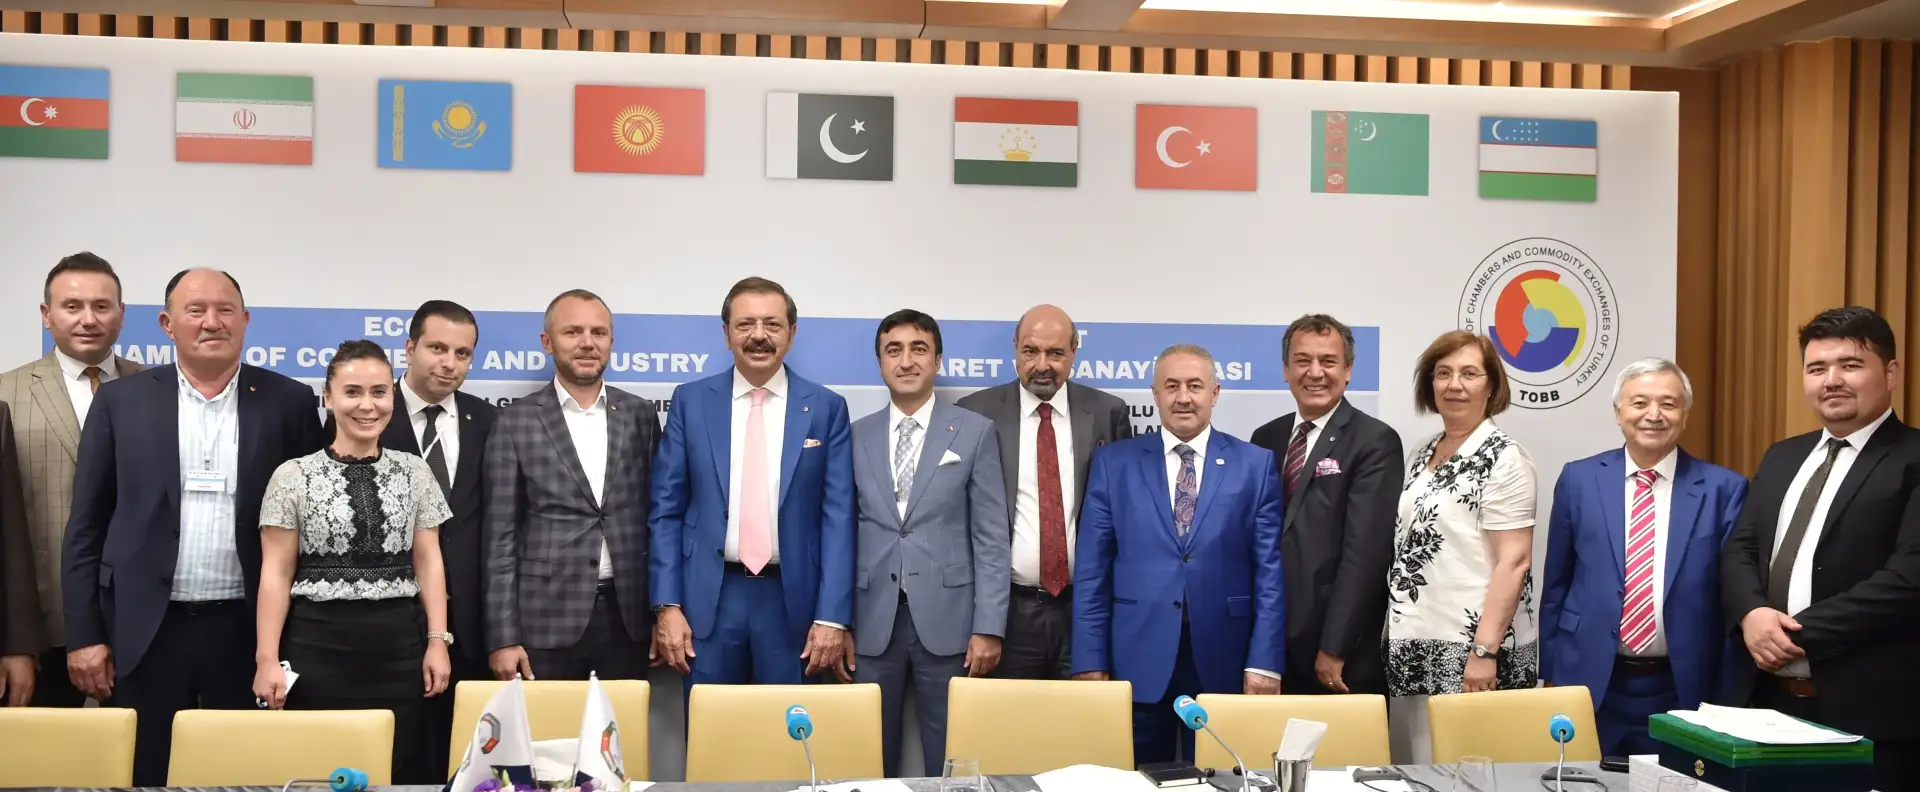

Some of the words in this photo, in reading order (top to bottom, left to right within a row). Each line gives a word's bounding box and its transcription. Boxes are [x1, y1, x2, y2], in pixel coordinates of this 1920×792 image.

[1502, 250, 1521, 266] AND
[1524, 247, 1585, 269] COMMODITY
[1467, 262, 1501, 314] CHAMBERS
[1583, 268, 1610, 331] EXCHANGES
[1600, 334, 1609, 349] OF
[245, 346, 287, 367] OF
[482, 350, 546, 370] AND
[610, 352, 709, 373] USTRY
[1576, 351, 1604, 386] TURKEY
[1213, 361, 1252, 381] ASI
[1519, 390, 1560, 403] TOBB
